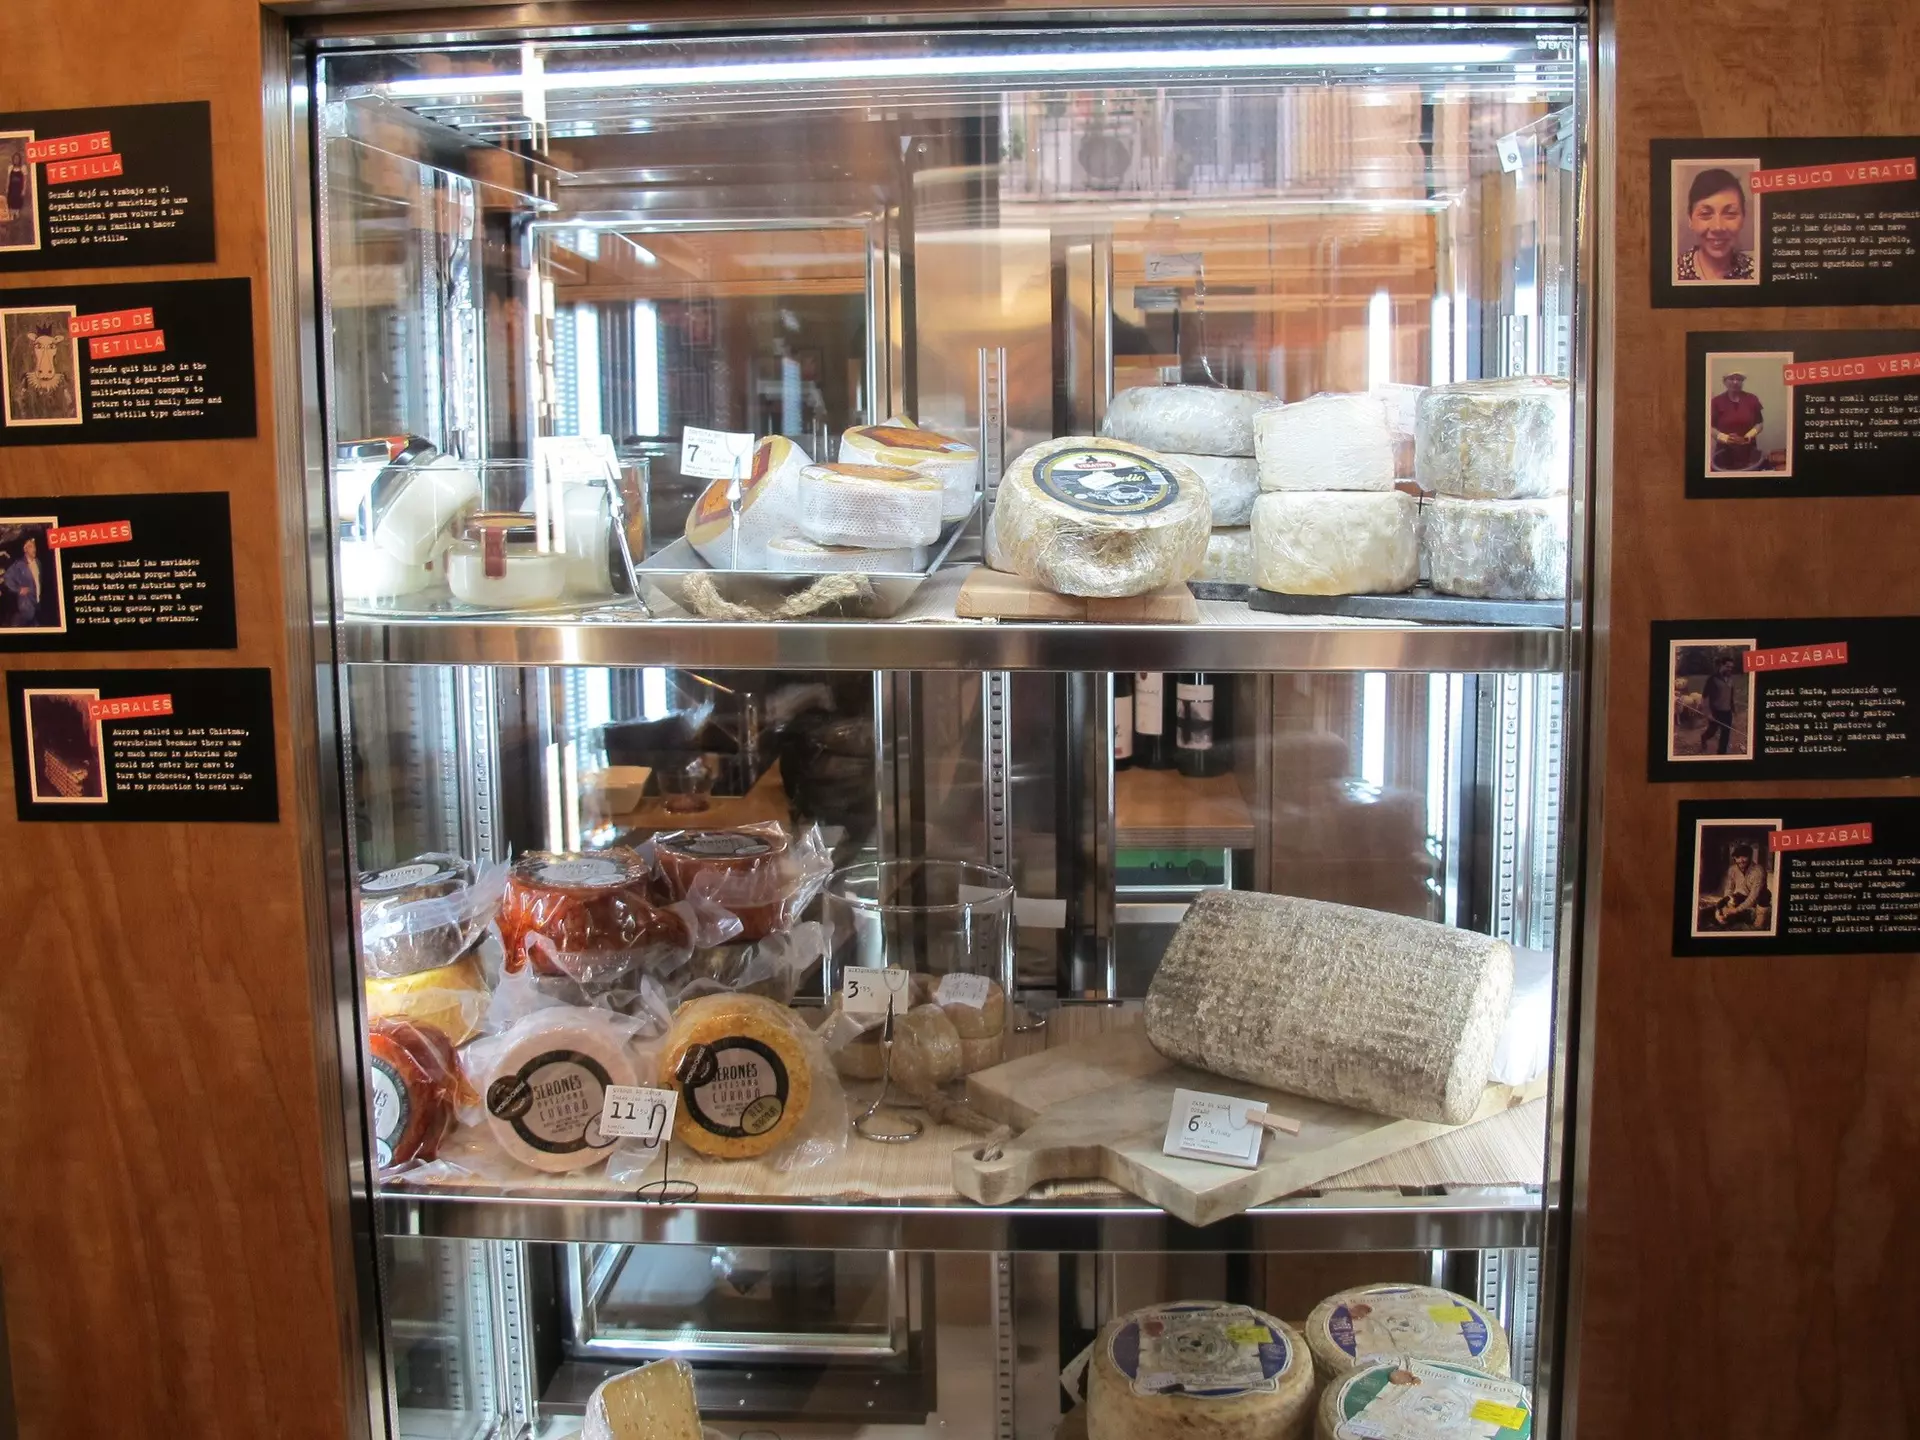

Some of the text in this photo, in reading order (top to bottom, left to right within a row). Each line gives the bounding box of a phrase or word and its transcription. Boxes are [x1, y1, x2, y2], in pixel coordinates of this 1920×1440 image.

[27, 137, 110, 158] QUESO DE
[49, 160, 122, 179] TETILLA
[1751, 164, 1915, 188] QUESUCO VERATO
[48, 190, 74, 198] Germán
[78, 189, 96, 198] dejó
[71, 313, 152, 333] QUESO DE
[92, 336, 164, 353] TETILLA
[90, 365, 117, 373] Germán
[162, 364, 175, 372] job
[1784, 364, 1864, 380] QUESUCO
[135, 376, 179, 384] department
[688, 444, 699, 462] 7
[50, 526, 130, 544] CABRALES
[174, 569, 196, 577] había
[1747, 648, 1845, 667] IDIAZÁBAL
[91, 699, 172, 716] CABRALES
[1773, 828, 1870, 846] IDIAZÁBAL
[847, 980, 859, 999] 3
[534, 1074, 582, 1100] SERONÉS
[610, 1101, 636, 1119] 11
[1188, 1115, 1201, 1131] 6
